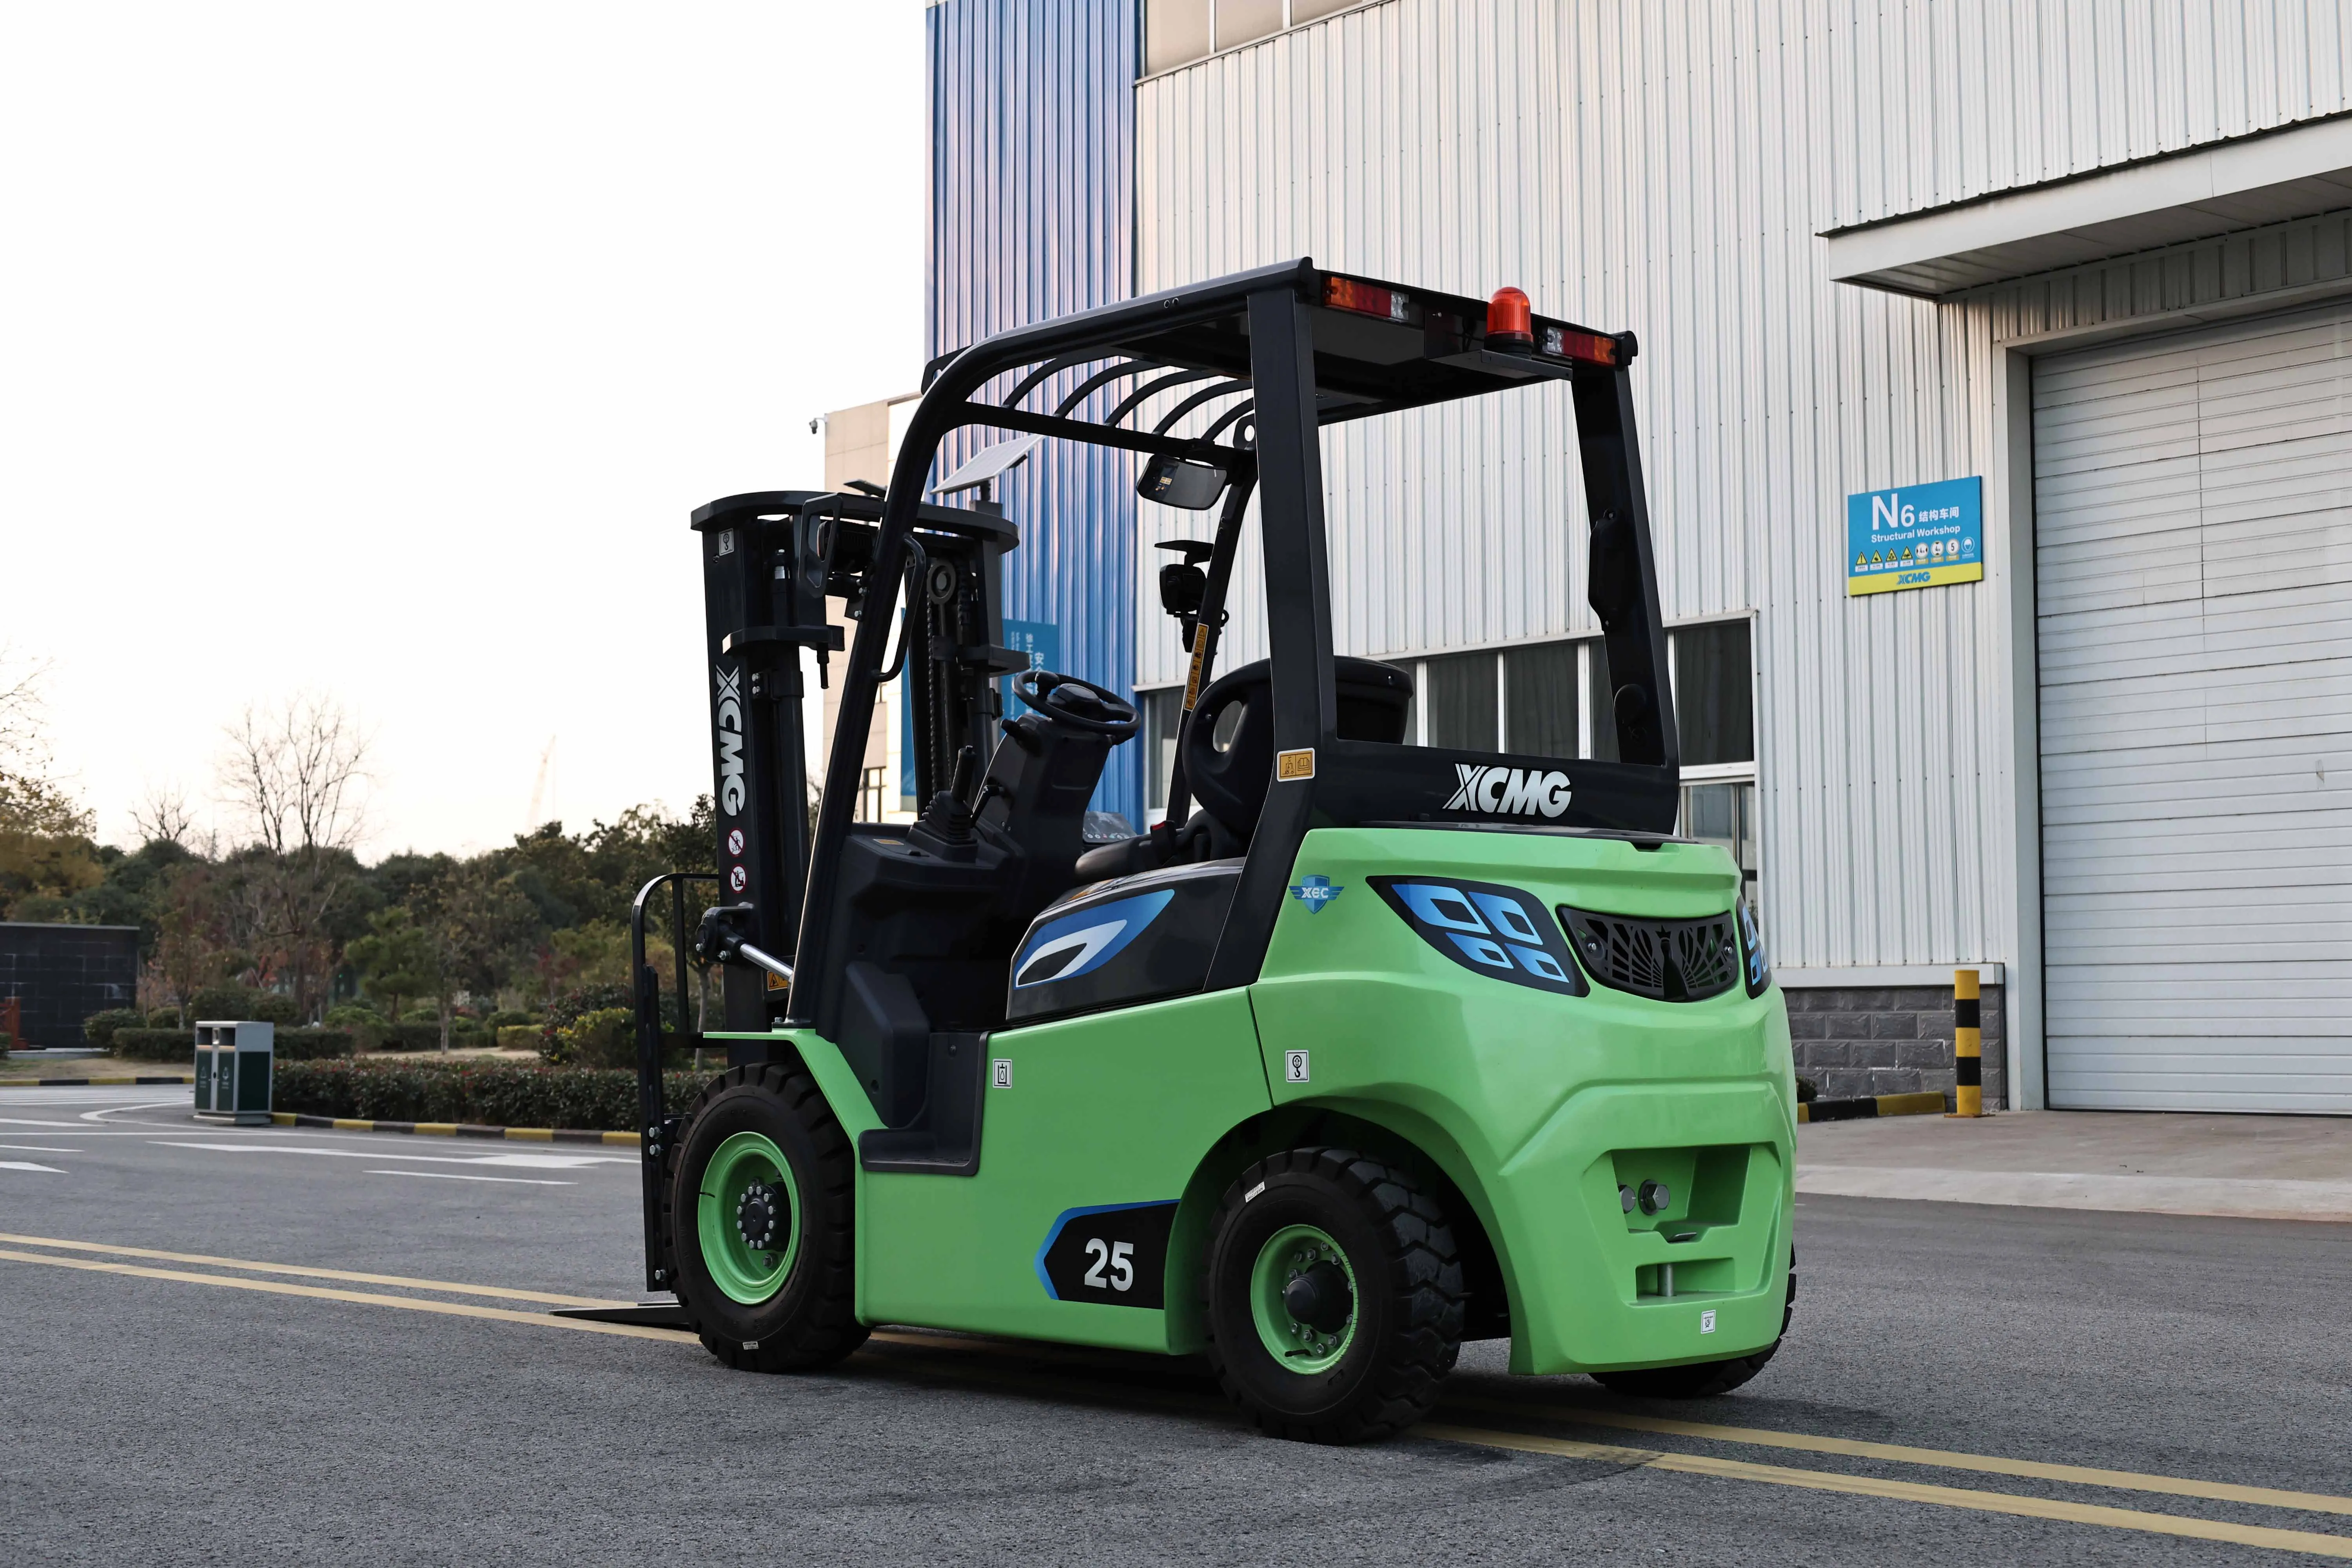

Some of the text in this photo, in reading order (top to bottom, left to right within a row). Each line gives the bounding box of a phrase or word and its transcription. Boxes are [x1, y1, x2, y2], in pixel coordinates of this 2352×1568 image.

[1872, 493, 1959, 530] N6 结构车间
[1871, 525, 1960, 543] Structural Workshop
[1951, 543, 1955, 551] 5
[1896, 571, 1931, 585] XCMG
[716, 664, 746, 817] XCMG
[1442, 763, 1572, 818] XCMG
[1084, 1238, 1134, 1292] 25
